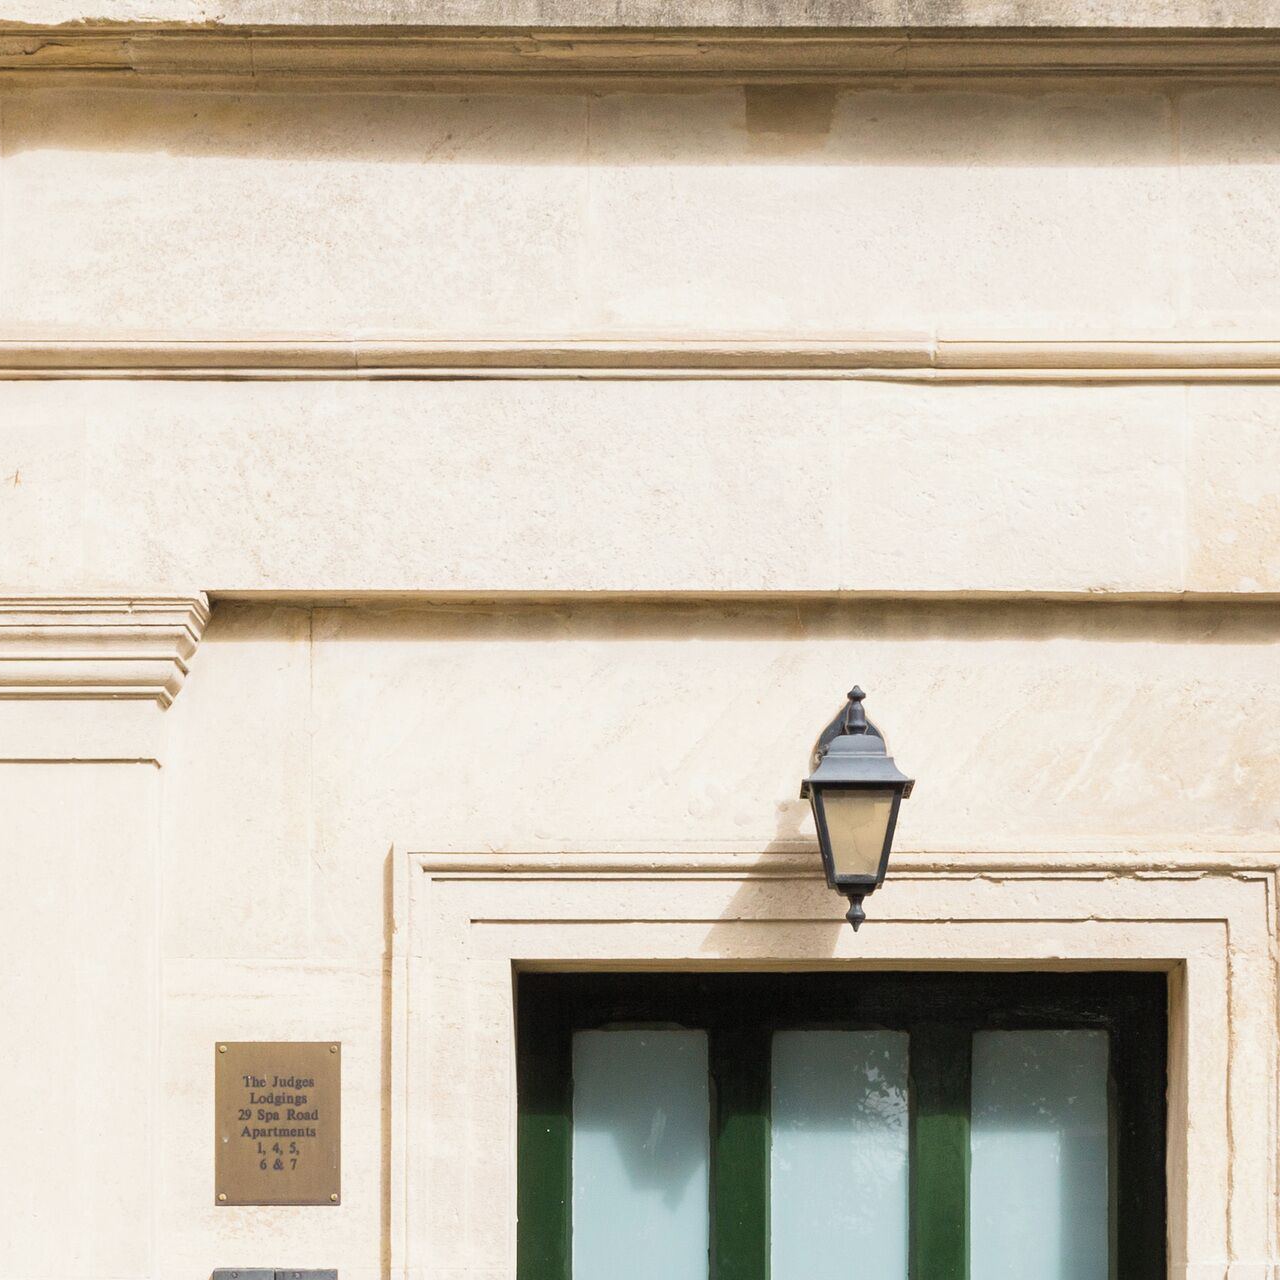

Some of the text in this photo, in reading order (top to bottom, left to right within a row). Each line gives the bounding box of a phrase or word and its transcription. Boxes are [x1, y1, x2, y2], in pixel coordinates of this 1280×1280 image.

[243, 1076, 315, 1089] The Judges
[250, 1093, 307, 1106] Lodgings
[238, 1109, 319, 1122] 29 Spa Road
[241, 1126, 316, 1139] Apartments
[257, 1142, 299, 1155] 1, 4, 5,
[260, 1159, 297, 1170] 6 & 7
